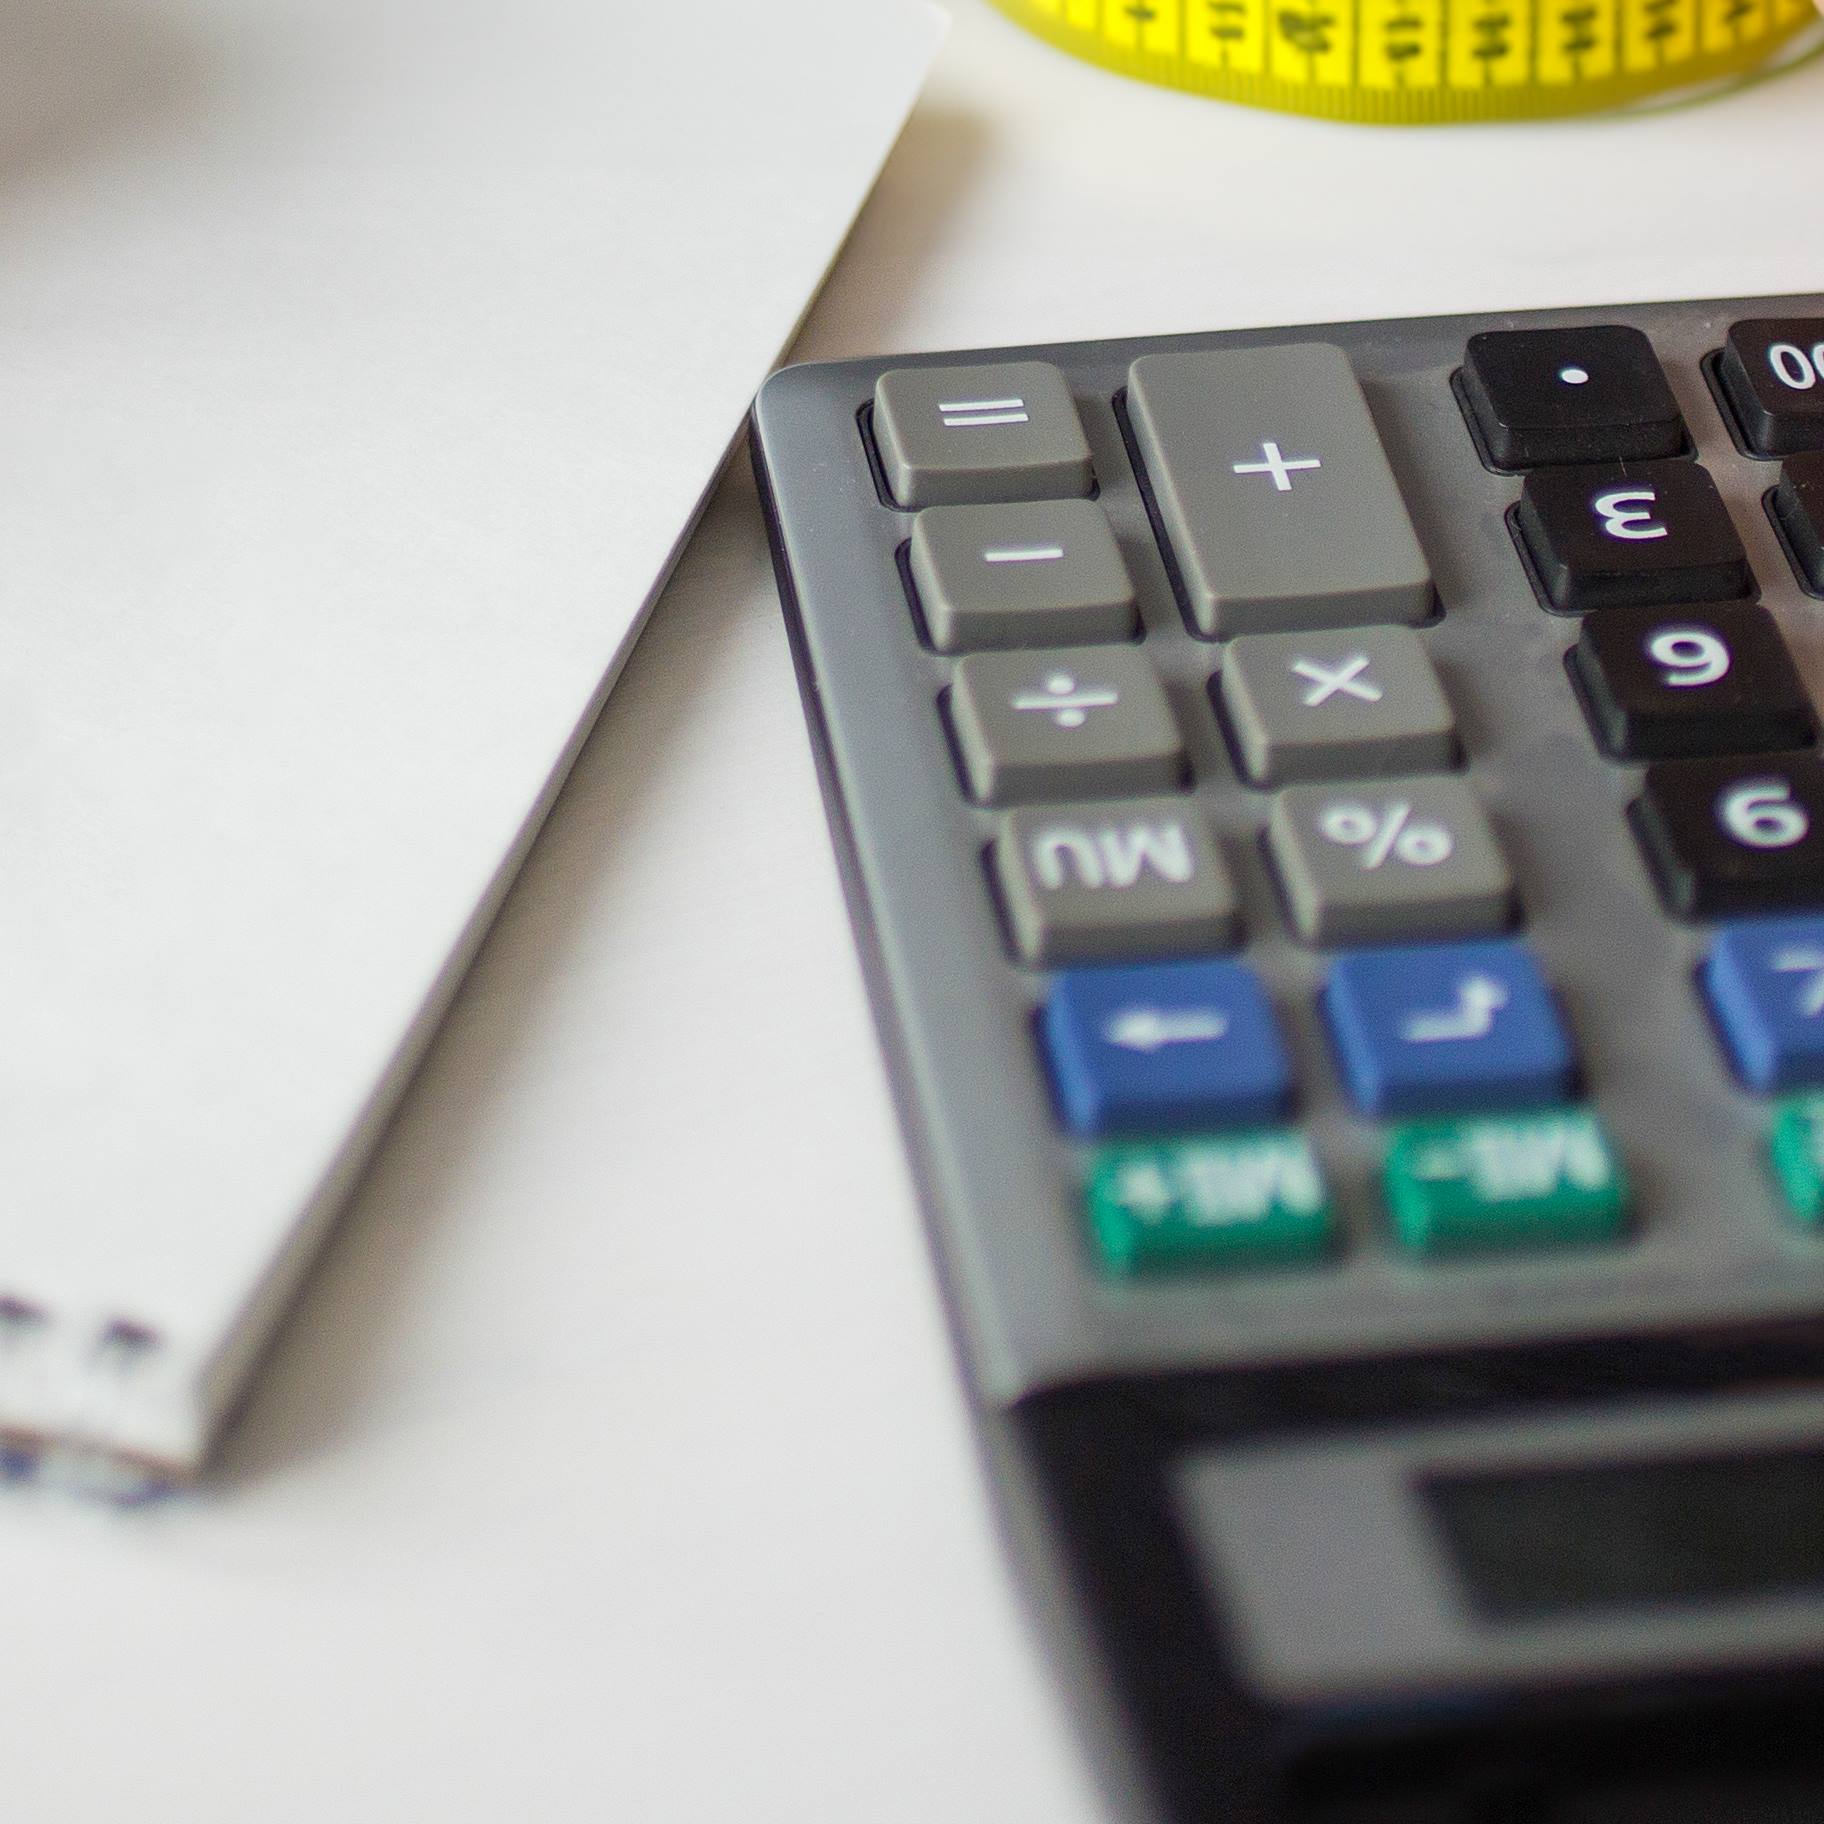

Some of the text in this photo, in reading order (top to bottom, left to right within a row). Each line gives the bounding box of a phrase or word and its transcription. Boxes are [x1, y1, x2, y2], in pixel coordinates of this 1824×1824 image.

[1593, 489, 1669, 540] 3
[1649, 630, 1731, 687] 6
[1722, 784, 1809, 848] 9
[1031, 821, 1194, 891] MU
